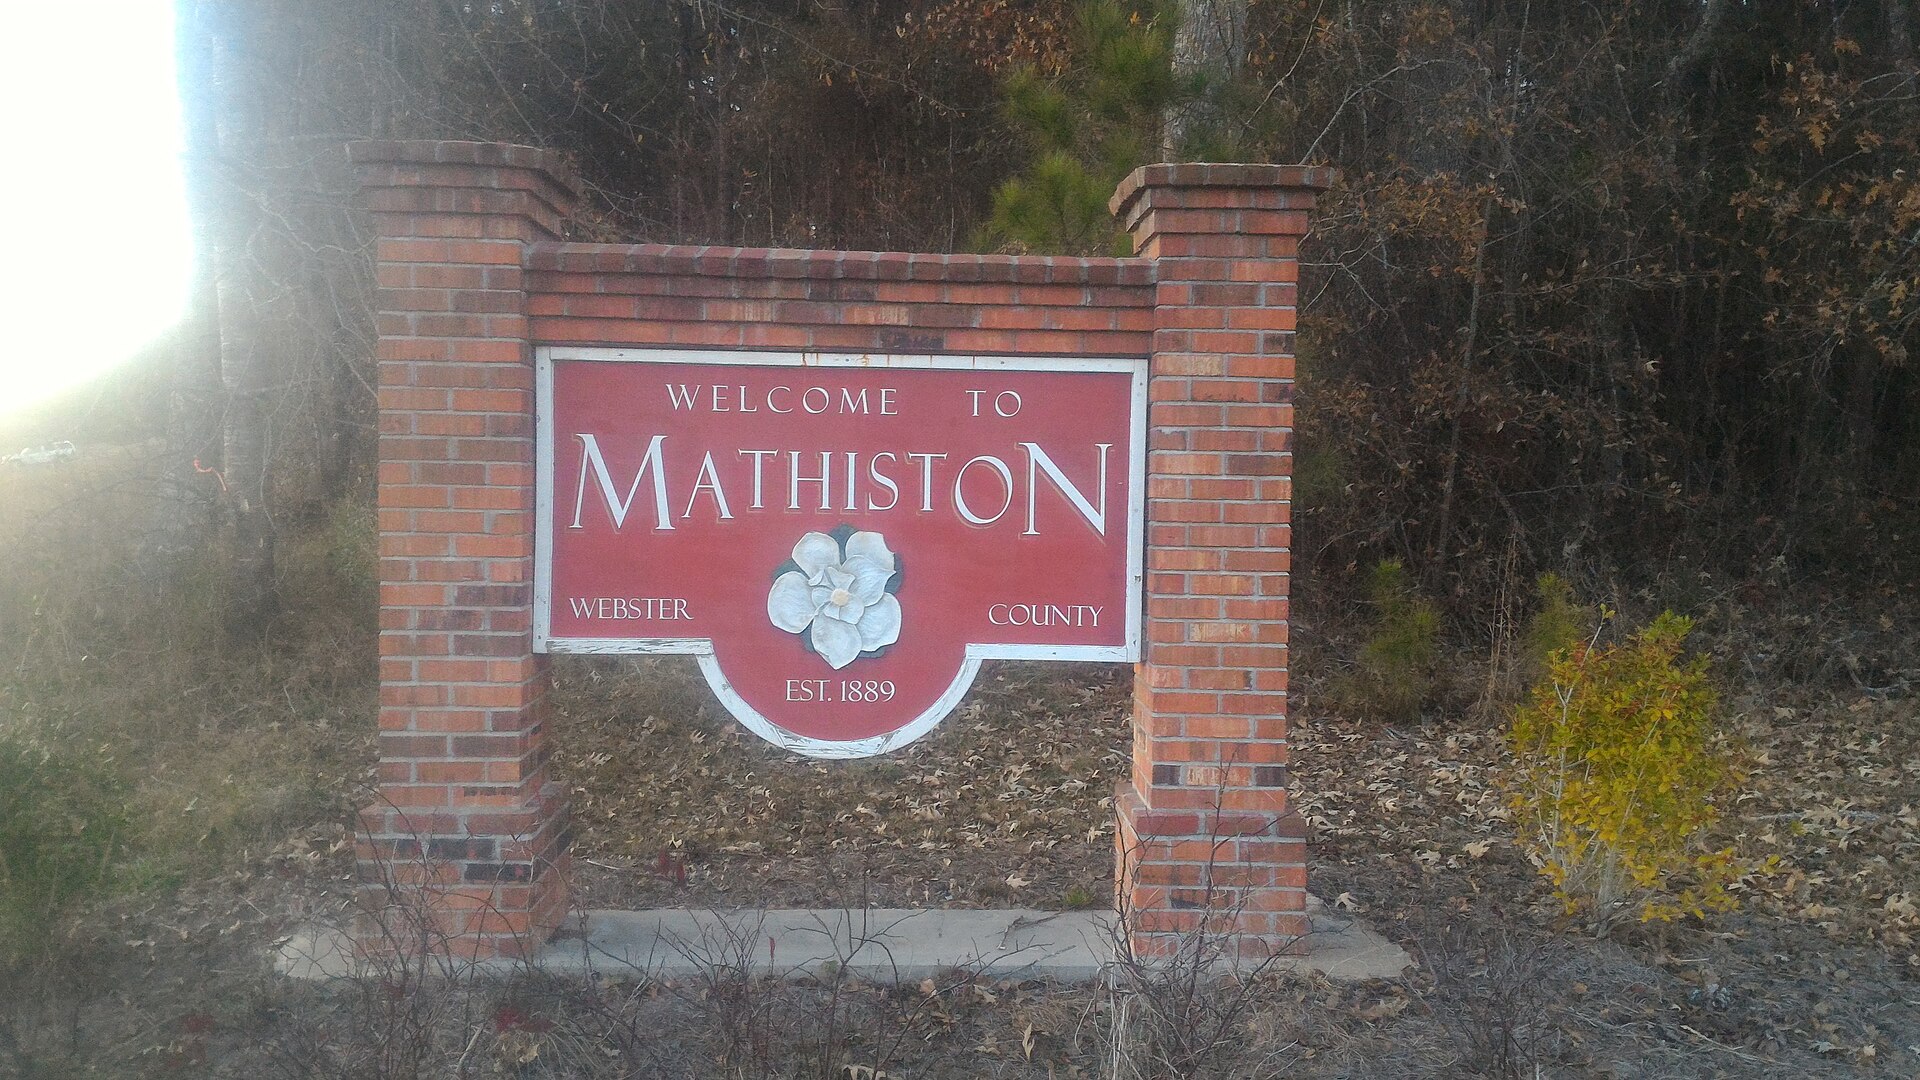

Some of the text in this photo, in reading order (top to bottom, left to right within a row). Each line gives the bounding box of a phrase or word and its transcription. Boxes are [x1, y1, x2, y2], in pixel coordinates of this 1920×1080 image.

[665, 383, 1022, 418] WELCOME TO
[568, 433, 1114, 537] MATHISTON
[568, 597, 1105, 627] WEBSTER COUNTY
[785, 679, 897, 703] EST. 1889
